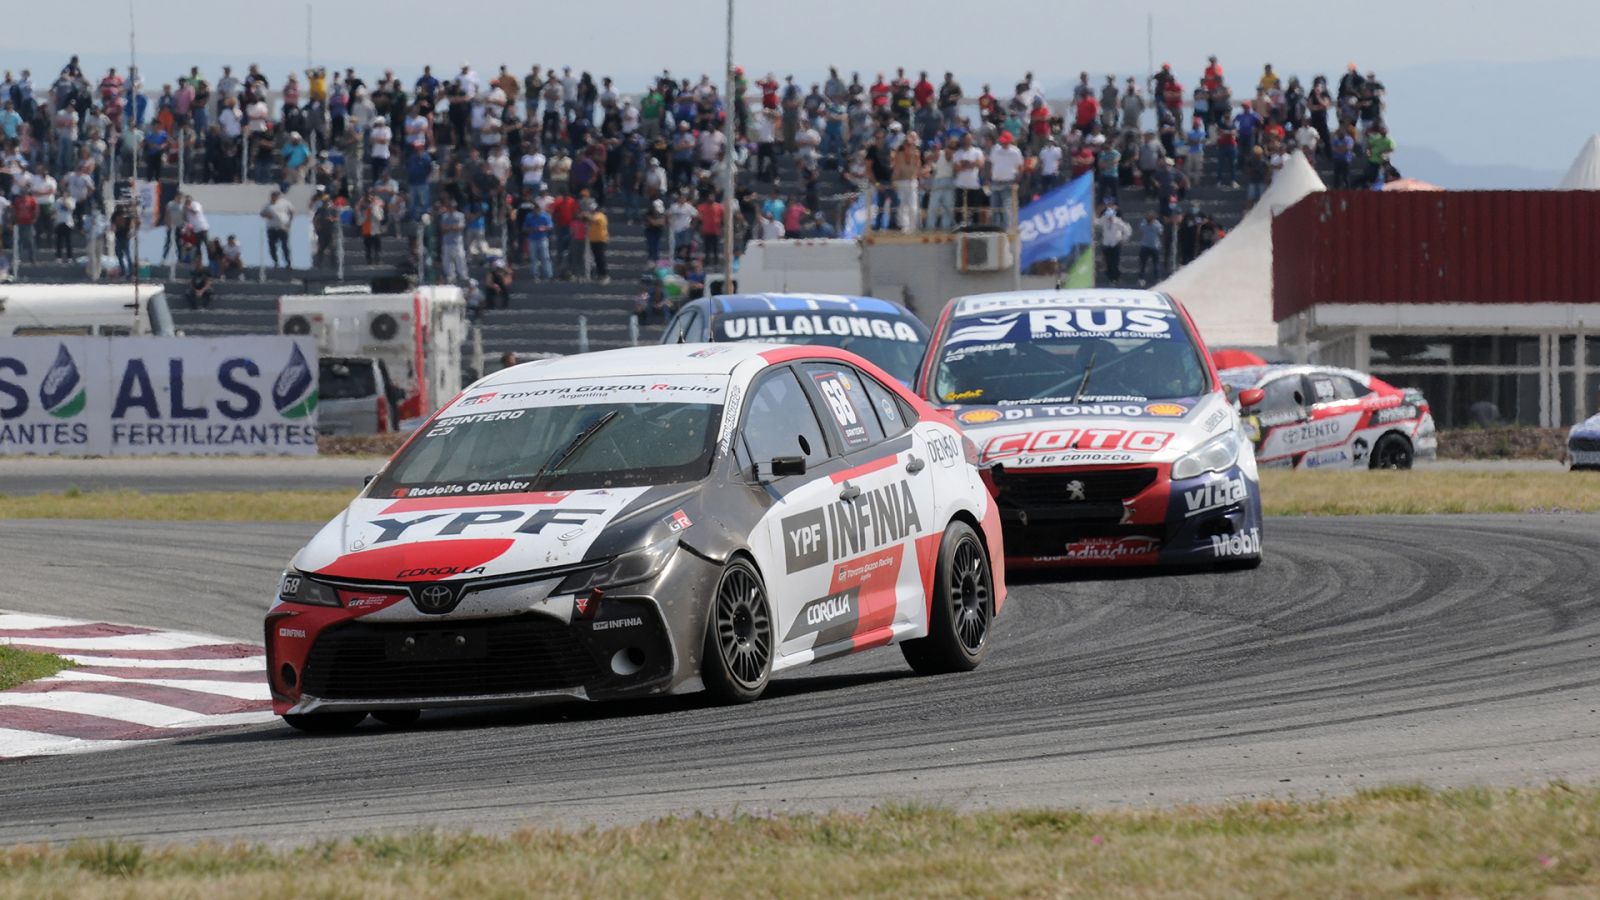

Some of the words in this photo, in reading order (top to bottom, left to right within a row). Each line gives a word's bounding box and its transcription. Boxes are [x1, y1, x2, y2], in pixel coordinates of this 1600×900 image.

[724, 315, 920, 343] VILLALONGA
[1028, 309, 1171, 333] RUS
[1031, 331, 1053, 339] RIO
[1055, 330, 1112, 339] URUGUAY
[1114, 331, 1172, 340] SEGUROS
[111, 357, 262, 420] ALS
[500, 387, 571, 399] TOYOTA
[576, 384, 646, 393] GAZOO
[650, 383, 721, 394] Racing
[559, 392, 608, 400] Argentina
[820, 379, 857, 426] 68
[997, 396, 1072, 407] Parabrisas
[434, 410, 526, 428] SANTERO
[1005, 407, 1033, 420] DI
[1042, 404, 1143, 416] TONDO
[111, 424, 316, 446] FERTILIZANTES
[426, 427, 456, 438] C3
[1300, 420, 1340, 441] ZENTO
[927, 435, 959, 463] DENSO
[985, 430, 1170, 458] COTO
[1017, 457, 1033, 465] Yo
[1041, 455, 1052, 463] te
[1061, 453, 1135, 462] conozco.
[408, 484, 463, 497] Rodolfo
[467, 480, 530, 492] Cristales
[368, 508, 607, 544] YPF
[669, 516, 693, 531] GR
[789, 523, 821, 557] YPF
[827, 479, 923, 561] INFINIA
[1210, 527, 1260, 558] Mobil
[396, 566, 486, 579] COROLLA
[282, 577, 300, 594] 68
[806, 594, 851, 626] COROLLA
[609, 617, 643, 629] INFINIA
